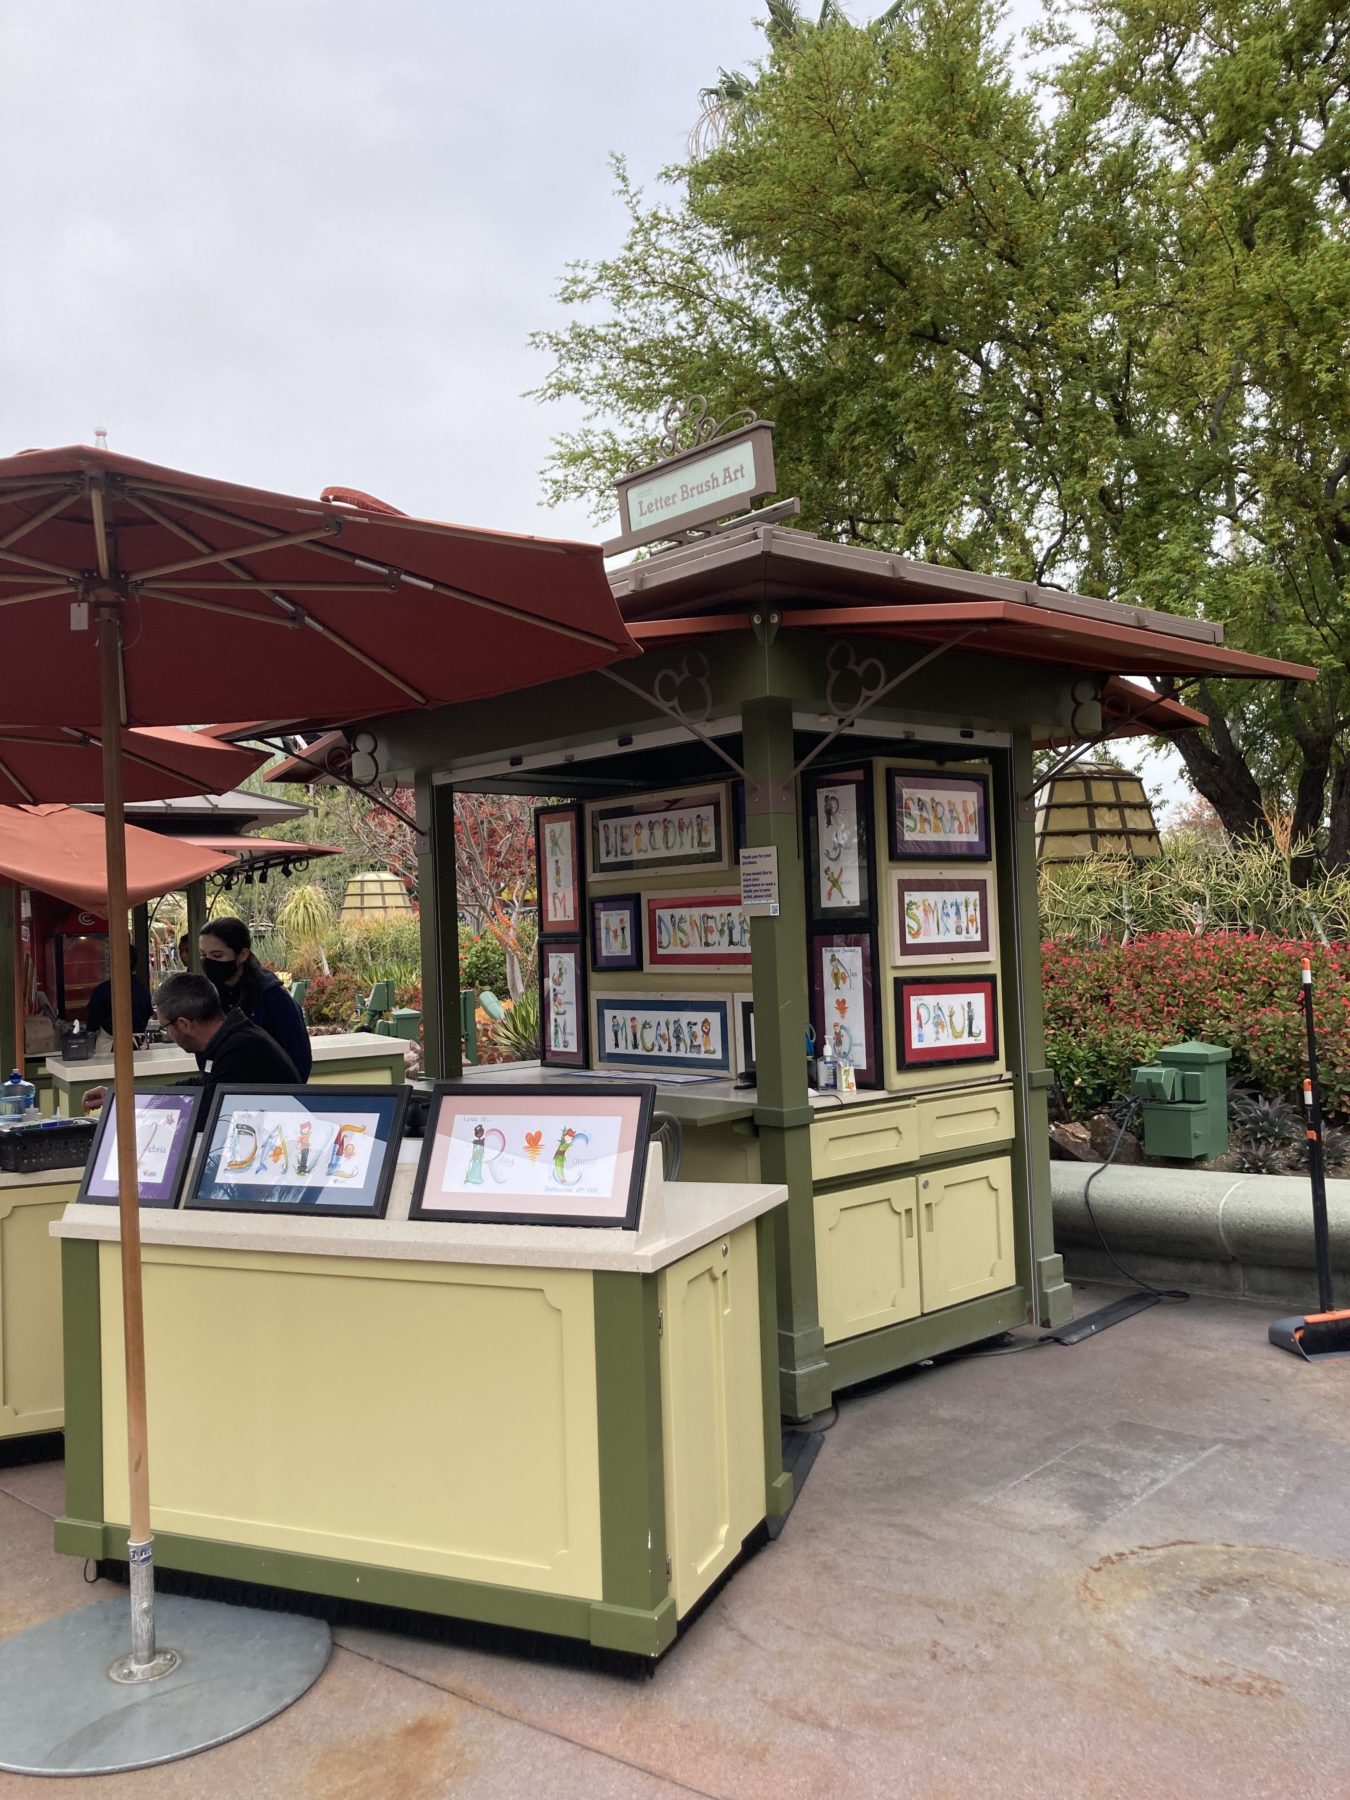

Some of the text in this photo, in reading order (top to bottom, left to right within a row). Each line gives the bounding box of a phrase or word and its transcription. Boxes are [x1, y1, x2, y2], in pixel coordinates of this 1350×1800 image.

[638, 463, 746, 517] Letter Brush Art
[602, 814, 709, 858] WELCOME
[906, 896, 978, 939] SMITH
[611, 1015, 716, 1054] MICHAEL
[917, 1001, 981, 1042] PAUL
[223, 1120, 366, 1179] DAVE
